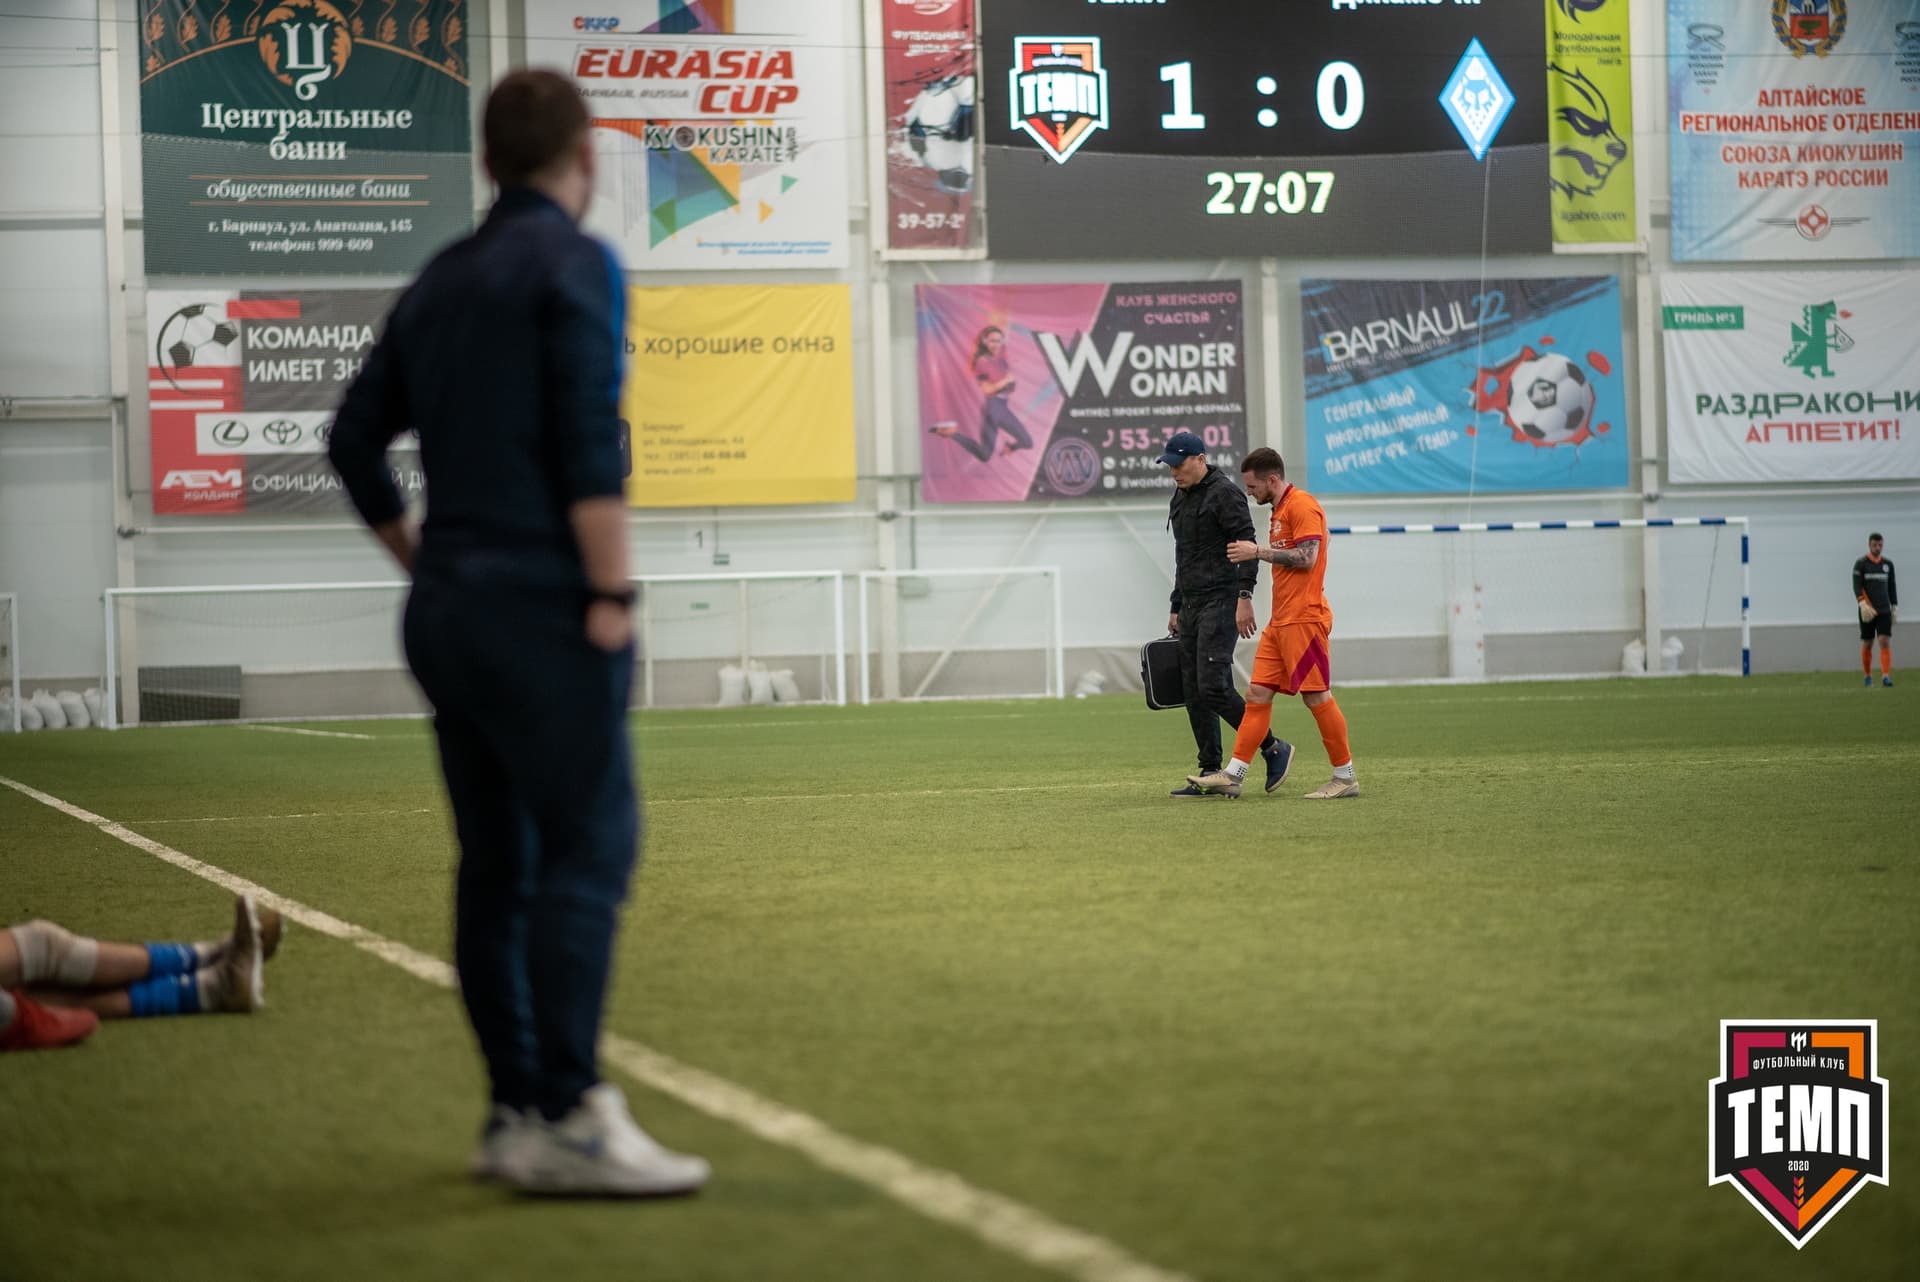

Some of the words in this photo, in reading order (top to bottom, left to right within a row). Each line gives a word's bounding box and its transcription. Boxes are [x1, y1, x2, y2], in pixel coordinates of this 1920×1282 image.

[700, 84, 799, 114] CUP
[1160, 62, 1206, 129] 1
[1316, 61, 1365, 130] 0
[1757, 87, 1866, 107] АЛТАЙСКОЕ
[200, 103, 413, 137] Центральные
[1681, 113, 1827, 133] РЕГИОНАЛЬНОЕ
[269, 134, 346, 161] бани
[709, 147, 783, 163] KARATE
[1722, 145, 1791, 164] СОЮЗА
[1797, 143, 1903, 163] КИОКУШИН
[1738, 170, 1810, 189] КАРАТЭ
[1814, 167, 1889, 187] РОССИИ
[206, 179, 356, 202] общественные
[360, 179, 411, 199] бани
[1206, 171, 1335, 214] 27:07
[222, 219, 287, 236] Барнаул,
[248, 238, 315, 254] телефон:
[1116, 294, 1153, 308] КЛУБ
[1156, 291, 1237, 306] ЖЕНСКОГО
[1143, 311, 1211, 325] СЧАСТЬЯ
[1674, 312, 1714, 324] ГРИЛЬ
[247, 326, 376, 352] КОМАНДА
[644, 336, 765, 360] хорошие
[772, 335, 836, 354] окна
[249, 361, 326, 383] ИМЕЕТ
[1112, 407, 1150, 417] ПРОЕКТ
[1153, 406, 1193, 416] НОВОГО
[1194, 403, 1242, 414] ФОРМАТА
[1324, 384, 1416, 424] ГЕНЕРАЛЬНЫЙ
[1696, 390, 1920, 419] РАЗДРАКОНИ
[1745, 419, 1900, 443] АППЕТИТ!
[1325, 446, 1383, 476] ПАРТНЕР
